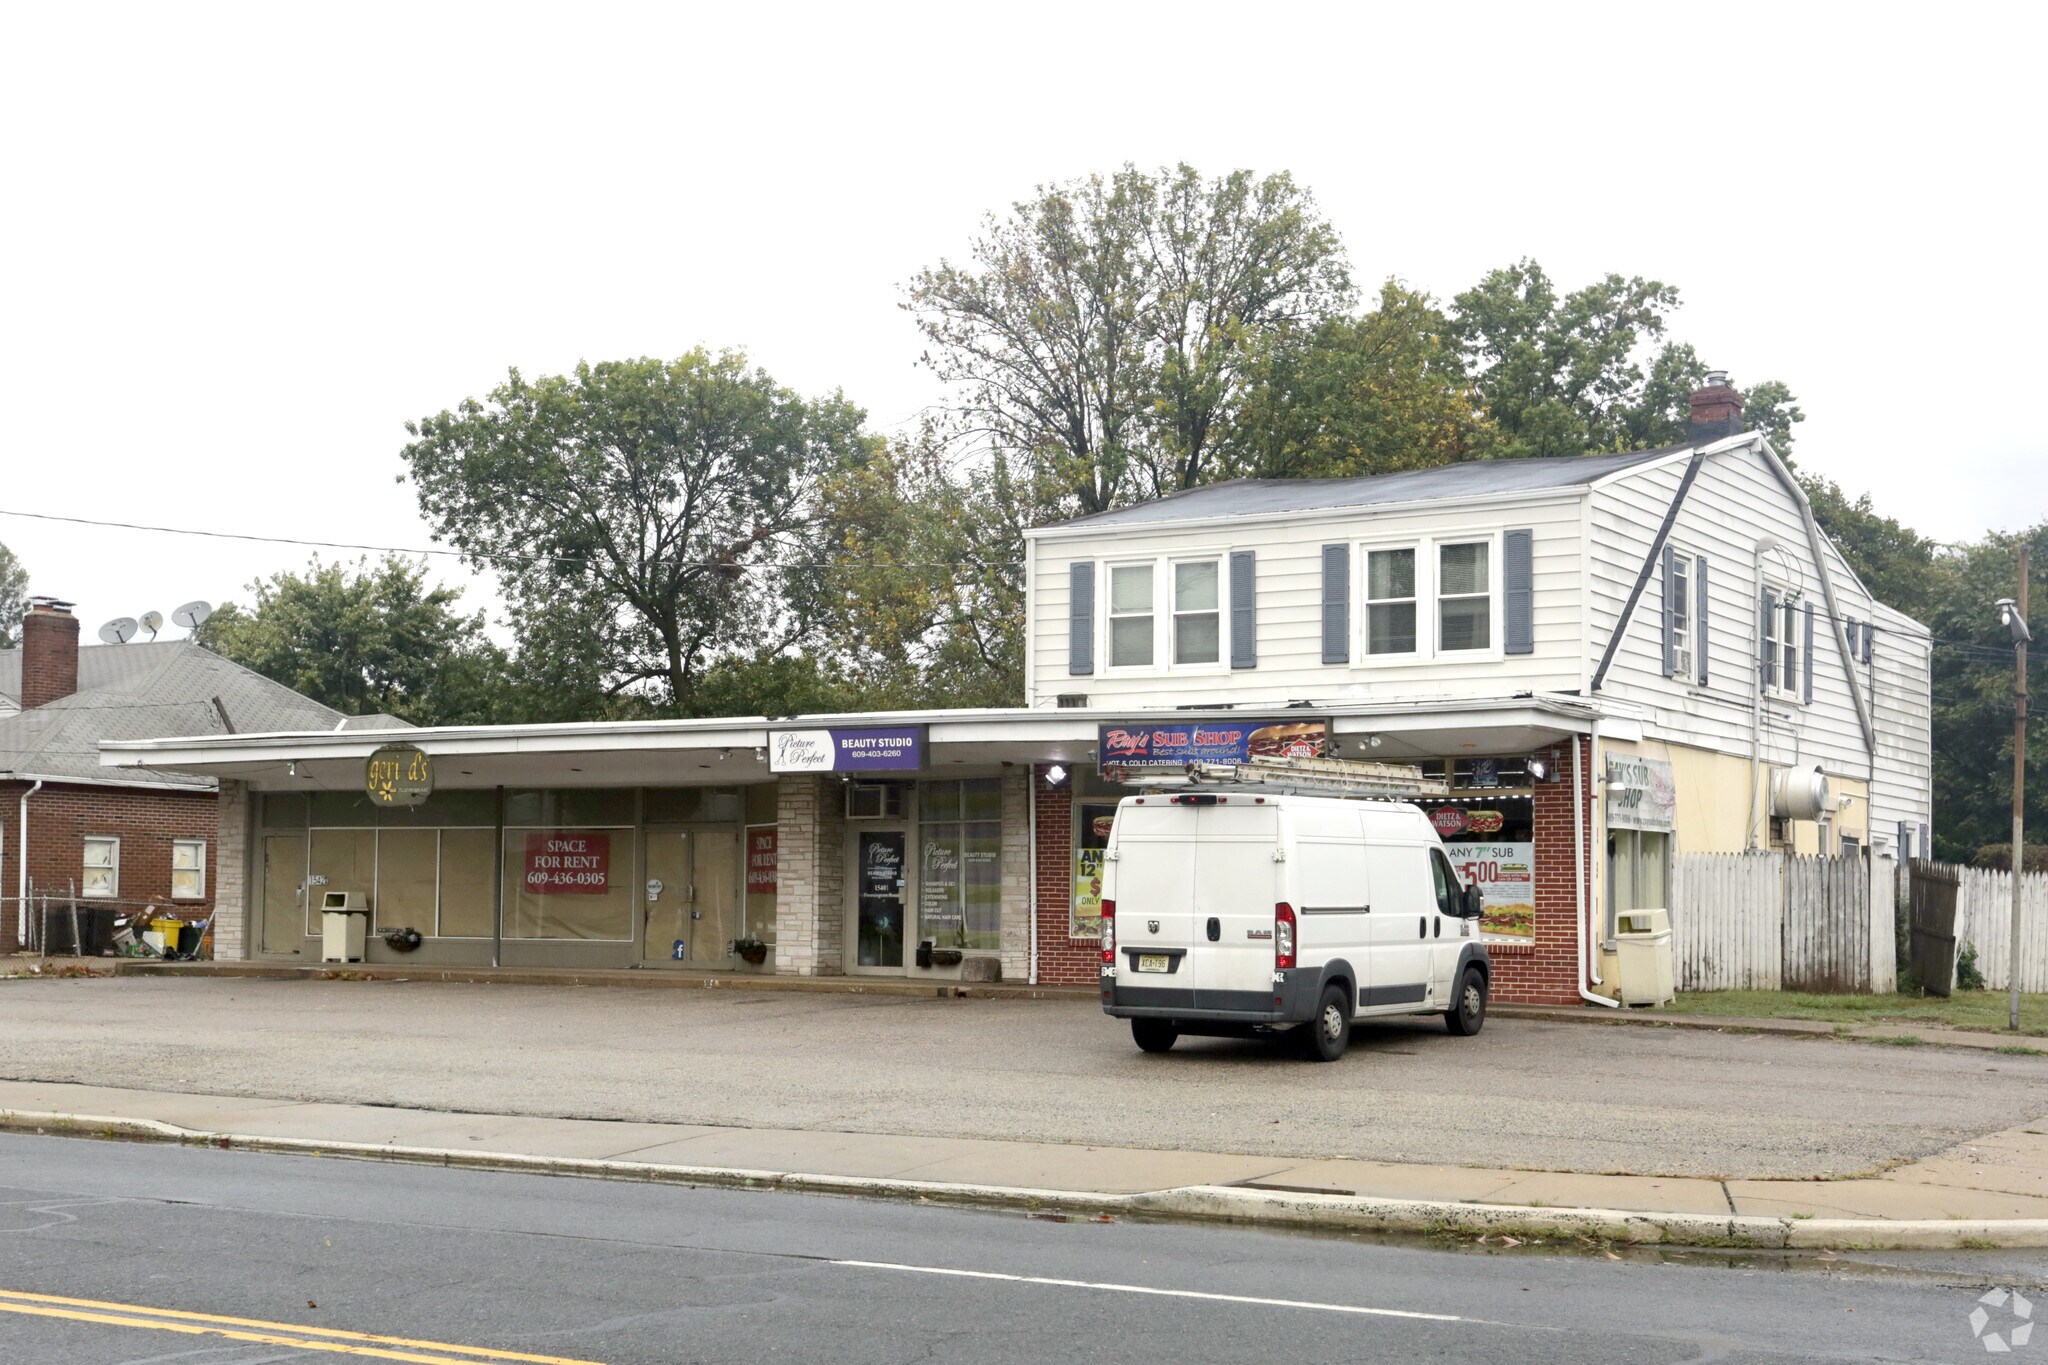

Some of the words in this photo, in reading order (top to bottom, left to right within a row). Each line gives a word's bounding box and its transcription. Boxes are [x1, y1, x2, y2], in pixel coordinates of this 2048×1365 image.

[778, 733, 815, 749] Picture
[841, 739, 877, 749] BEAUTY
[878, 737, 912, 747] STUDIO
[1106, 729, 1150, 756] Ray's
[1152, 731, 1189, 747] SUB
[1193, 729, 1242, 746] SHOP
[790, 748, 826, 768] Perfect
[852, 750, 901, 758] 609-403-6260
[1152, 747, 1174, 756] Best
[369, 755, 399, 790] geri
[408, 752, 427, 781] d's
[1632, 765, 1649, 786] SUB
[547, 840, 586, 853] SPACE
[924, 842, 952, 856] Picture
[1449, 847, 1473, 857] ANY
[1492, 847, 1514, 857] SUB
[534, 856, 561, 869] FOR
[563, 856, 600, 869] RENT
[931, 855, 958, 872] Perfect
[527, 872, 605, 885] 609-436-0305
[1081, 897, 1101, 905] ONLY
